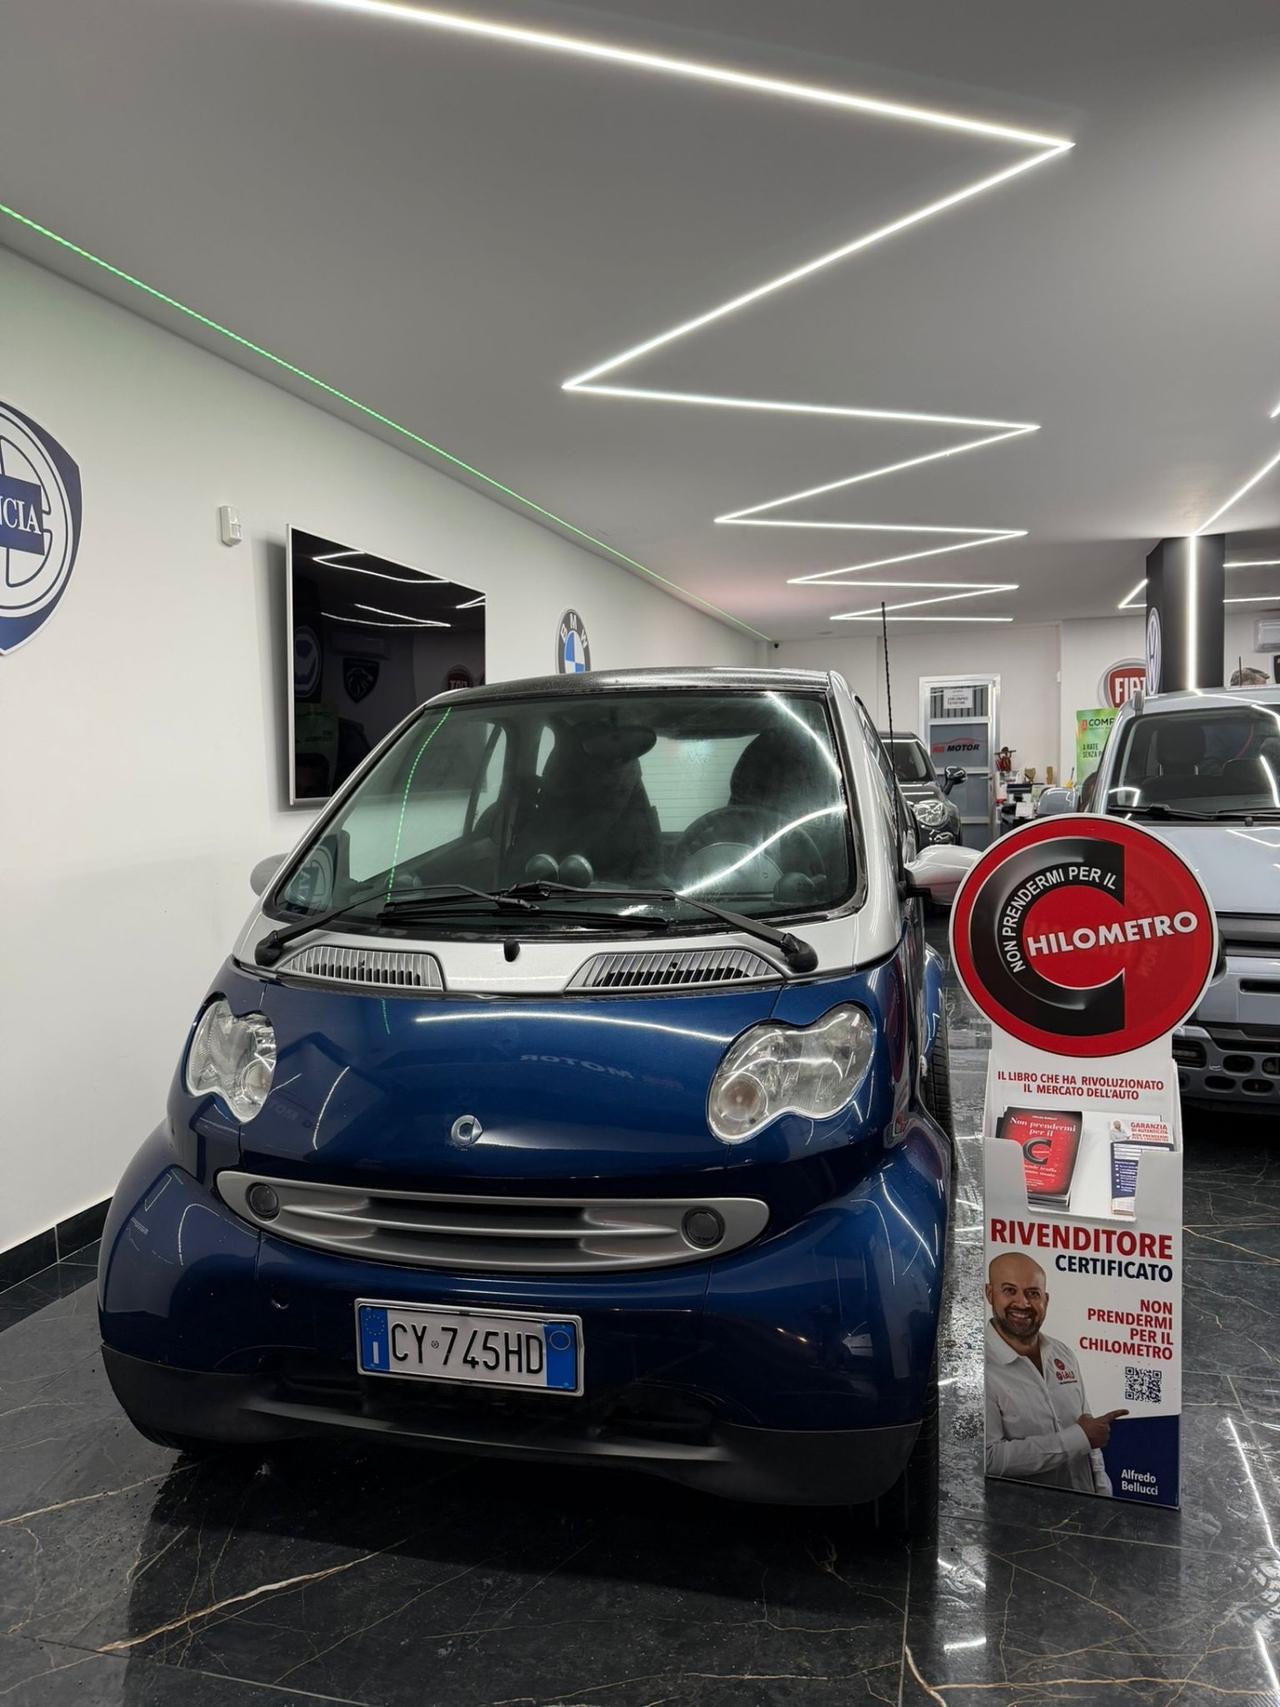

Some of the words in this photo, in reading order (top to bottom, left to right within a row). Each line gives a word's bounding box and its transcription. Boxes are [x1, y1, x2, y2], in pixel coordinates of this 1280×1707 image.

[560, 613, 588, 648] BMW
[1115, 676, 1146, 704] FIAT
[947, 744, 980, 752] MOTOR
[1069, 866, 1100, 883] PER
[1103, 872, 1117, 890] IL
[1002, 868, 1065, 938] PRENDERMI
[1004, 940, 1026, 973] NON
[997, 1071, 1007, 1080] IL
[1008, 1071, 1038, 1083] LIBRO
[1040, 1073, 1060, 1085] CHE
[1062, 1075, 1077, 1085] HA
[1081, 1076, 1164, 1091] RIVOLUZIONATO
[1023, 1084, 1033, 1093] IL
[1036, 1084, 1084, 1096] MERCATO
[1010, 1116, 1028, 1126] Non
[1029, 1121, 1077, 1133] prendermi
[1029, 1128, 1046, 1136] per
[1131, 1122, 1168, 1130] GARANZIA
[990, 1218, 1173, 1260] RIVENDITORE
[1055, 1254, 1173, 1283] CERTIFICATO
[1140, 1299, 1173, 1316] NON
[1087, 1308, 1173, 1331] PRENDERMI
[1130, 1328, 1157, 1345] PER
[1161, 1331, 1174, 1346] IL
[391, 1322, 428, 1364] CY
[440, 1326, 544, 1375] 745HD
[1079, 1336, 1173, 1361] CHILOMETRO
[1121, 1468, 1157, 1484] Alfredo
[1121, 1481, 1159, 1496] Bellucci
